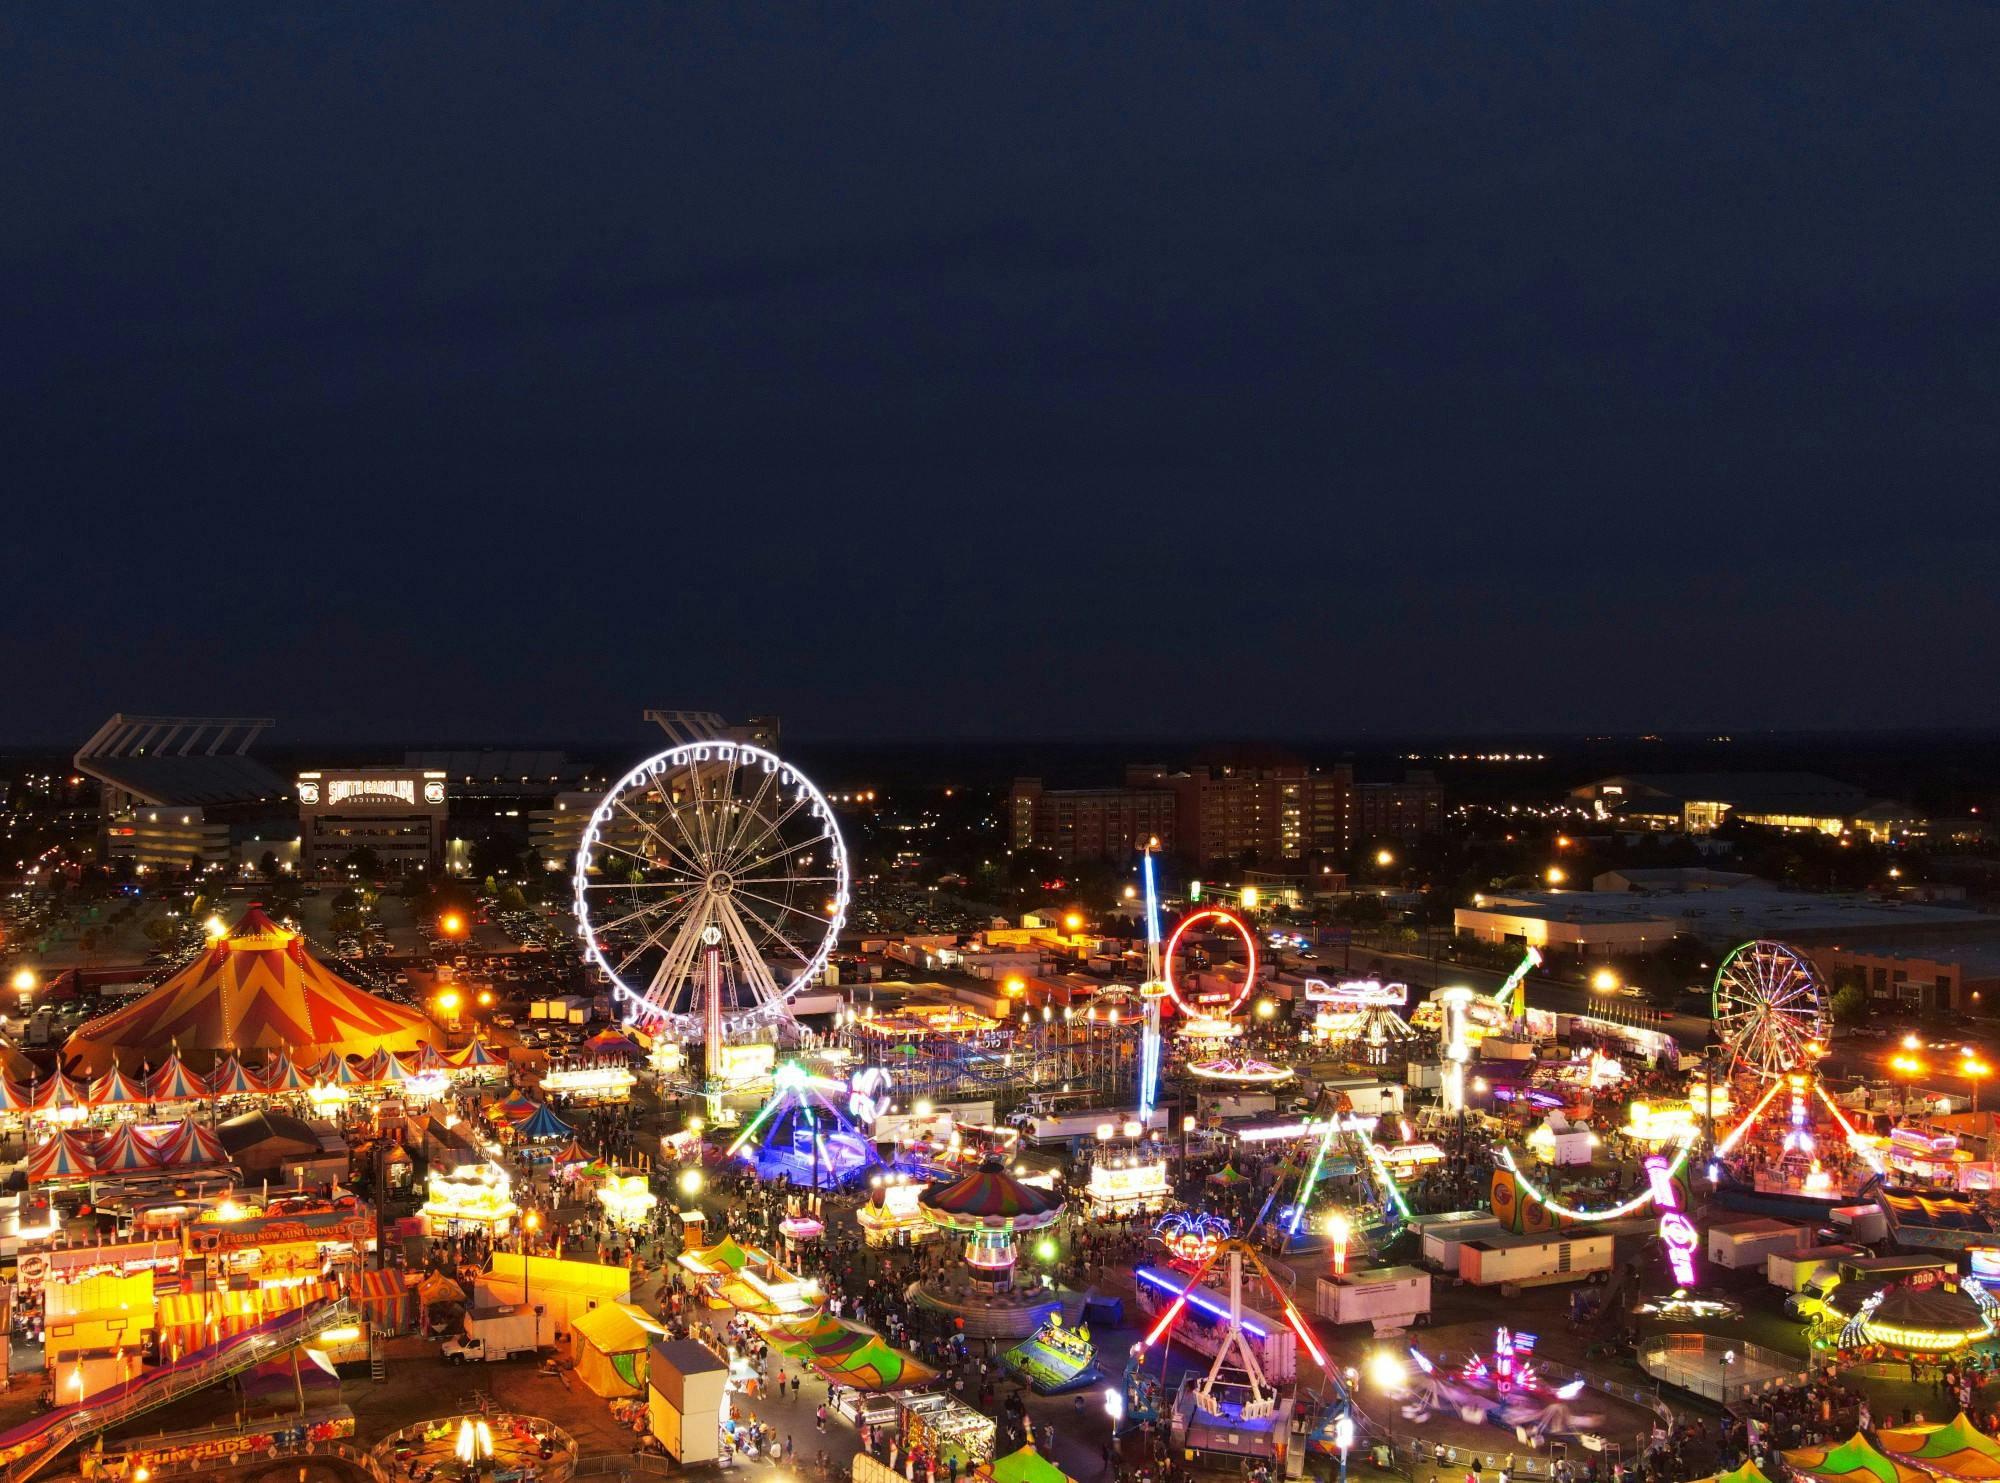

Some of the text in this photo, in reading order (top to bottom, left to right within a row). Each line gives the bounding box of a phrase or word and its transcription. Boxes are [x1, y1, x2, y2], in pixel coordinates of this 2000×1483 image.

[328, 780, 415, 806] SOUTH CAROLINA
[223, 1233, 256, 1243] FRESH
[281, 1228, 304, 1239] MINI
[307, 1224, 346, 1236] DONUTS
[1912, 1273, 1934, 1285] 3000
[140, 1438, 253, 1467] FUN SLIDE
